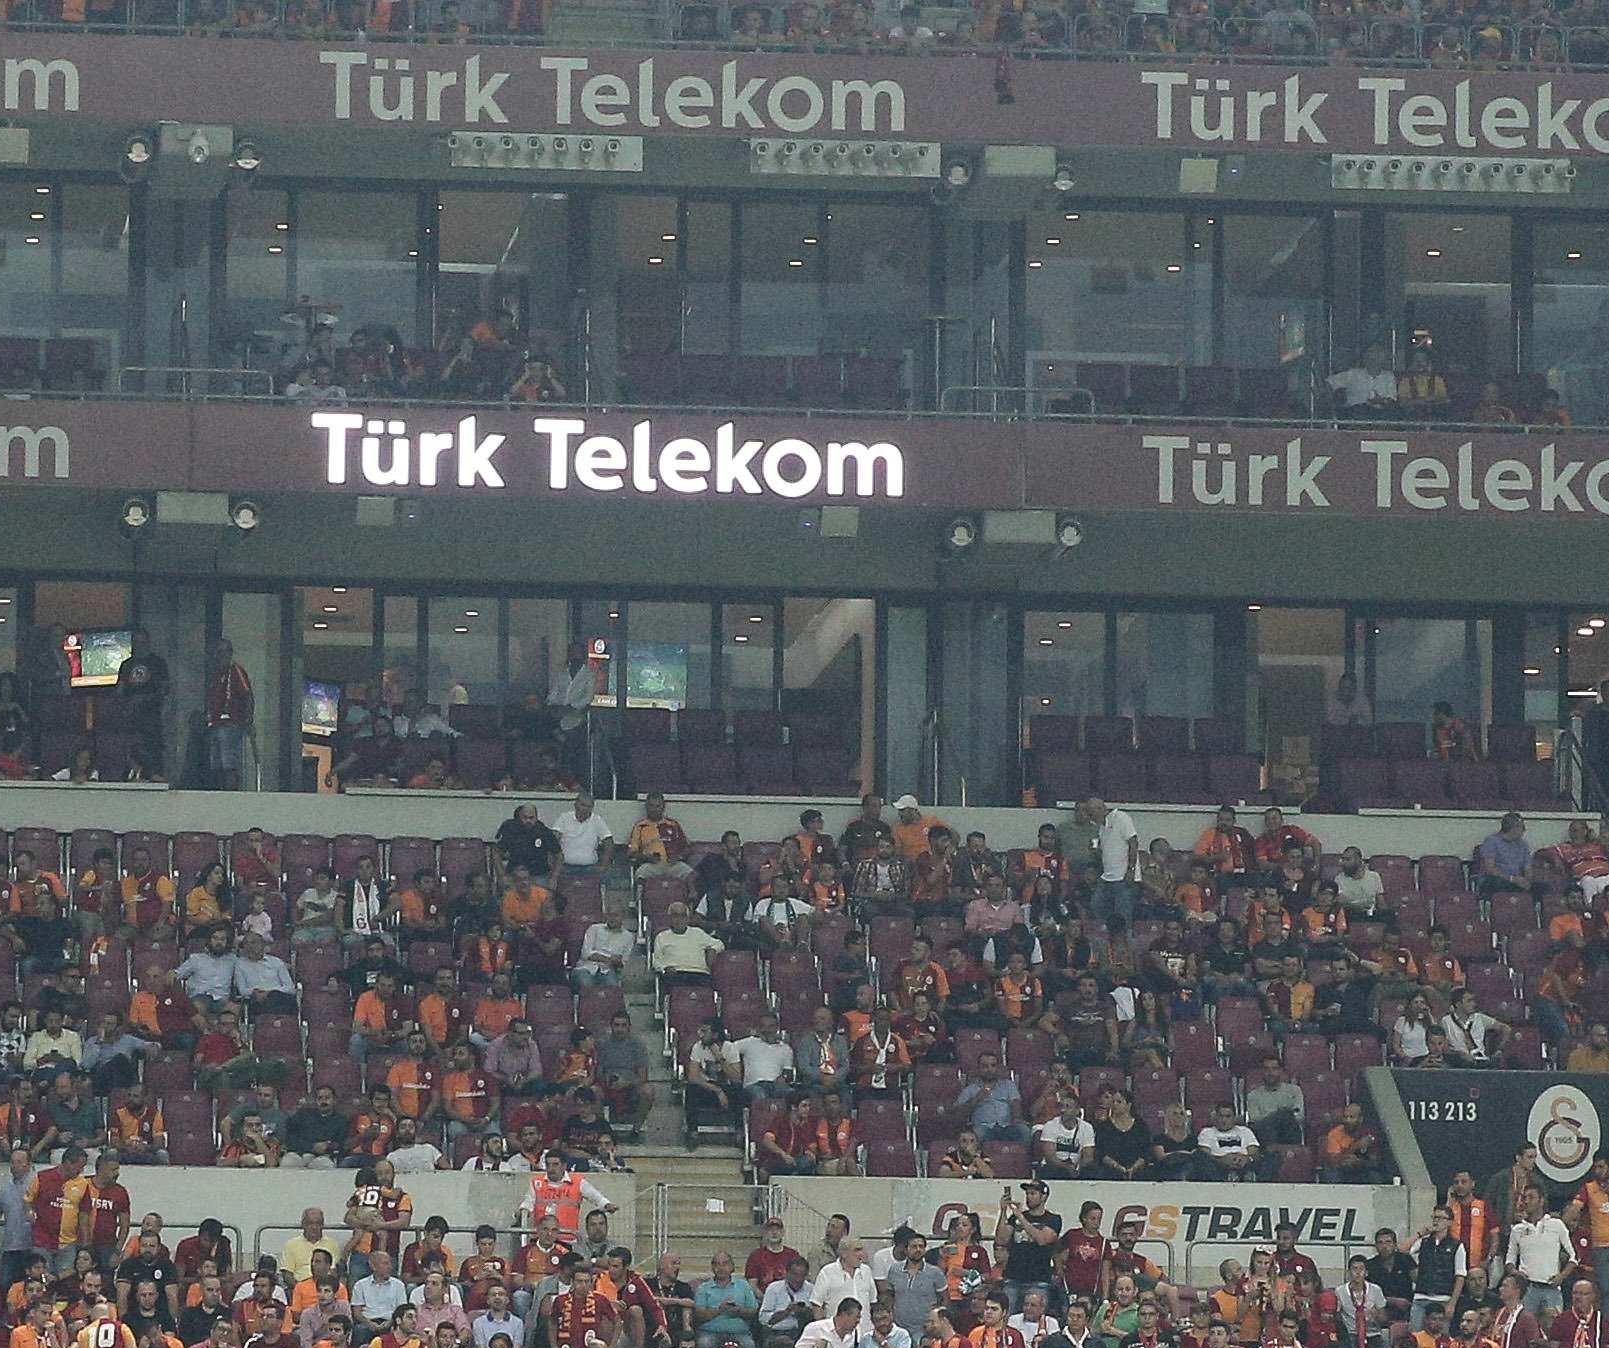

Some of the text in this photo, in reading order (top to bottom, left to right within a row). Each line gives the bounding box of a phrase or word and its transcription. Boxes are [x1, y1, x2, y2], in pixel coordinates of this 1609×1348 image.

[320, 51, 905, 132] Türk Telekom
[1141, 72, 1328, 143] Türk
[312, 413, 903, 497] Türk Telekom
[1143, 436, 1331, 506] Türk
[1408, 1099, 1478, 1123] 113 213
[1113, 1205, 1365, 1242] GSTRAVEL
